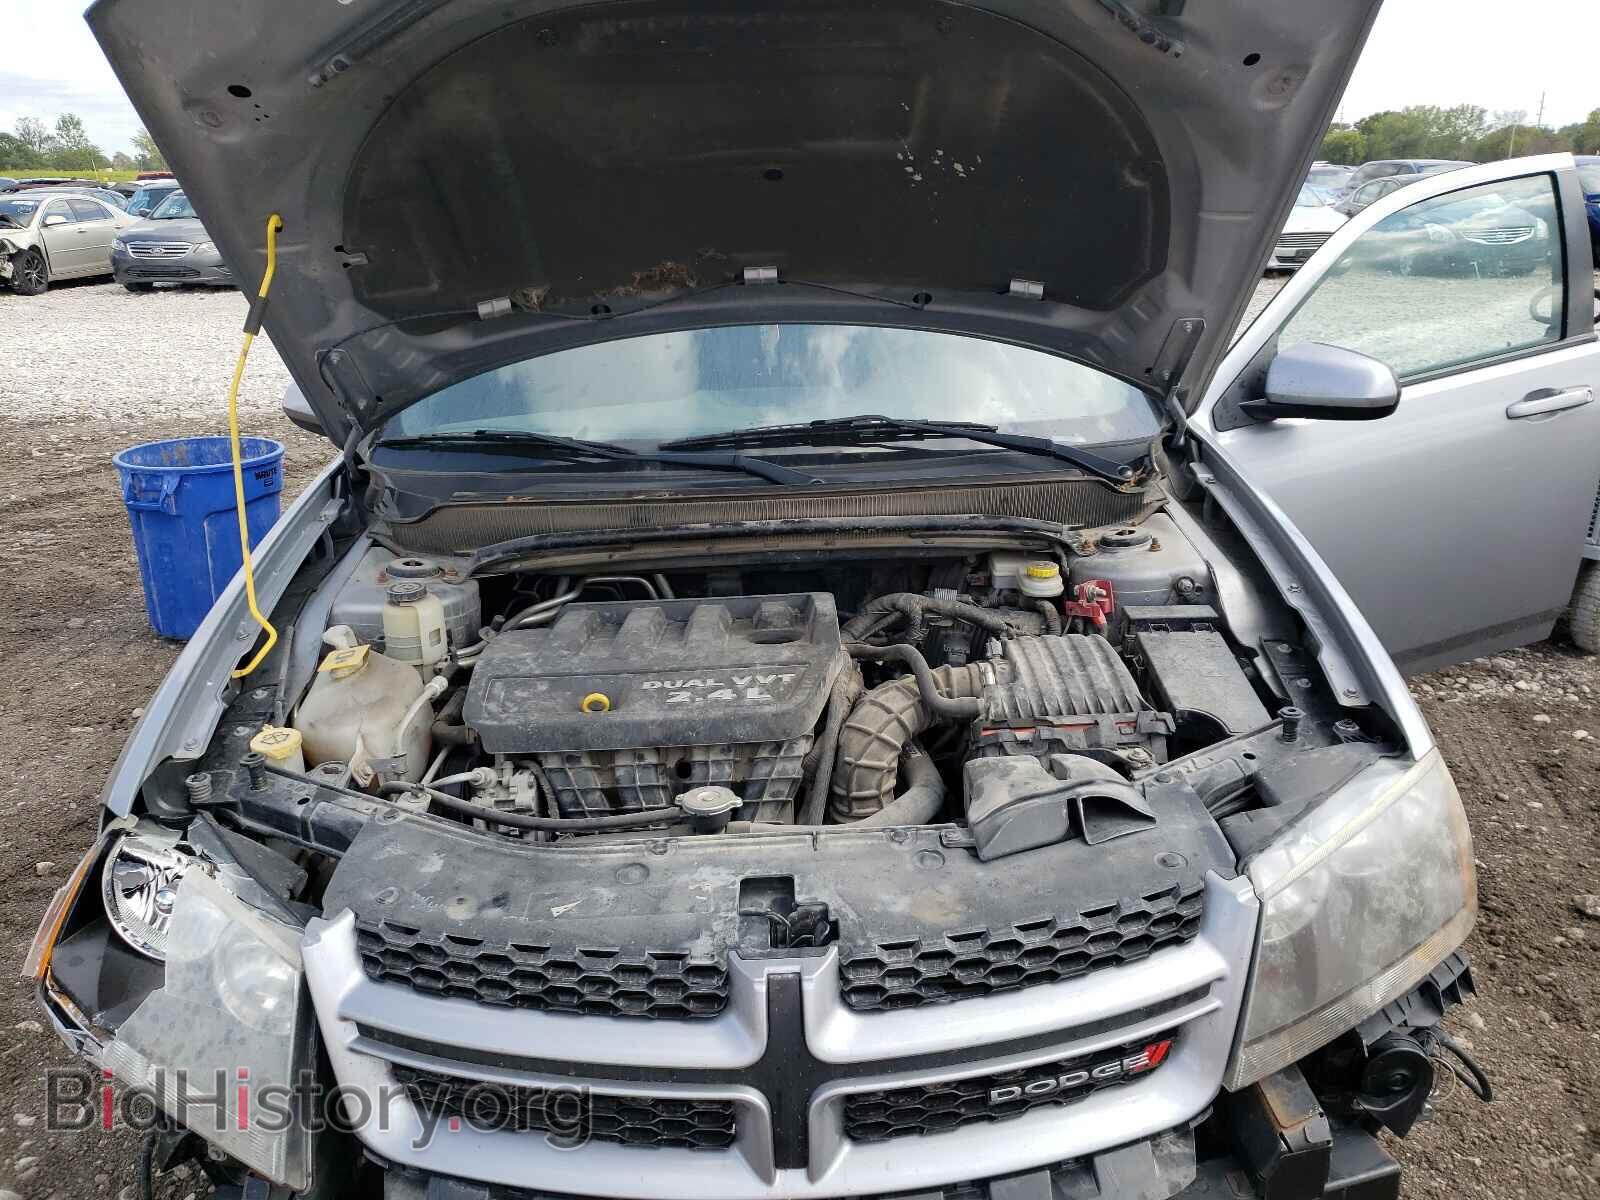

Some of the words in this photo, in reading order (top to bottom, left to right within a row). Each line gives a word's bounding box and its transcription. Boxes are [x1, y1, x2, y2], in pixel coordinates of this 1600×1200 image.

[641, 678, 725, 690] DUAL
[730, 673, 796, 687] VVT
[990, 1051, 1151, 1105] DODGE
